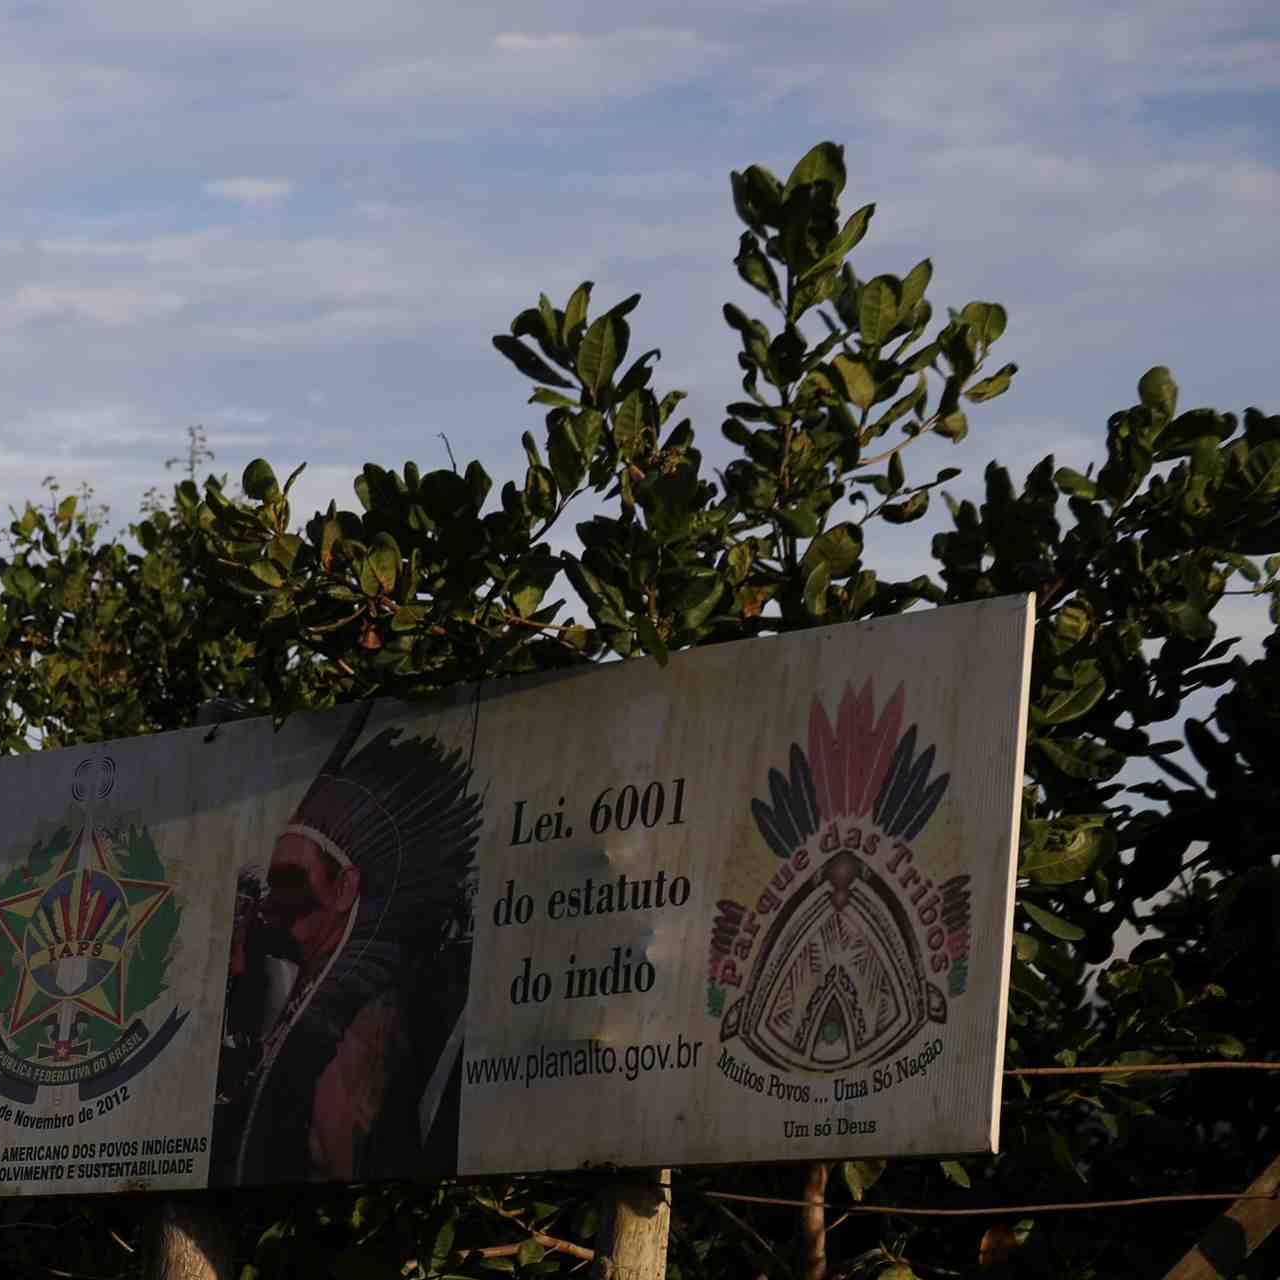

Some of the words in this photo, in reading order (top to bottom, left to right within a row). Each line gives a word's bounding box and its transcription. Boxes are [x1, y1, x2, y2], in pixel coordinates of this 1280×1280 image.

[510, 796, 572, 846] Lei.
[590, 778, 686, 834] 6001
[493, 880, 533, 926] do
[547, 871, 690, 920] estatuto
[720, 850, 810, 988] Parque
[820, 822, 880, 855] das
[886, 842, 949, 972] Tribos
[510, 958, 551, 1004] do
[33, 1064, 90, 1081] FEDERATIVA
[93, 1057, 106, 1071] DO
[108, 1032, 142, 1064] BRASIL
[467, 1035, 704, 1087] www.planalto.gov.br
[717, 1048, 764, 1092] Muitos
[767, 1074, 810, 1103] Povos
[833, 1078, 868, 1101] Uma
[873, 1067, 892, 1093] Só
[896, 1038, 944, 1084] Nação
[15, 1110, 74, 1129] Novembro
[78, 1106, 93, 1123] de
[96, 1086, 130, 1115] 2012
[784, 1121, 808, 1138] Um
[814, 1118, 831, 1136] só
[837, 1118, 876, 1135] Deus
[1, 1145, 69, 1161] AMERICANO
[72, 1144, 96, 1158] DOS
[99, 1141, 137, 1157] POVOS
[142, 1136, 207, 1154] INDÍGENAS
[67, 1165, 75, 1178] E
[78, 1159, 193, 1178] SUSTENTABILIDADE
